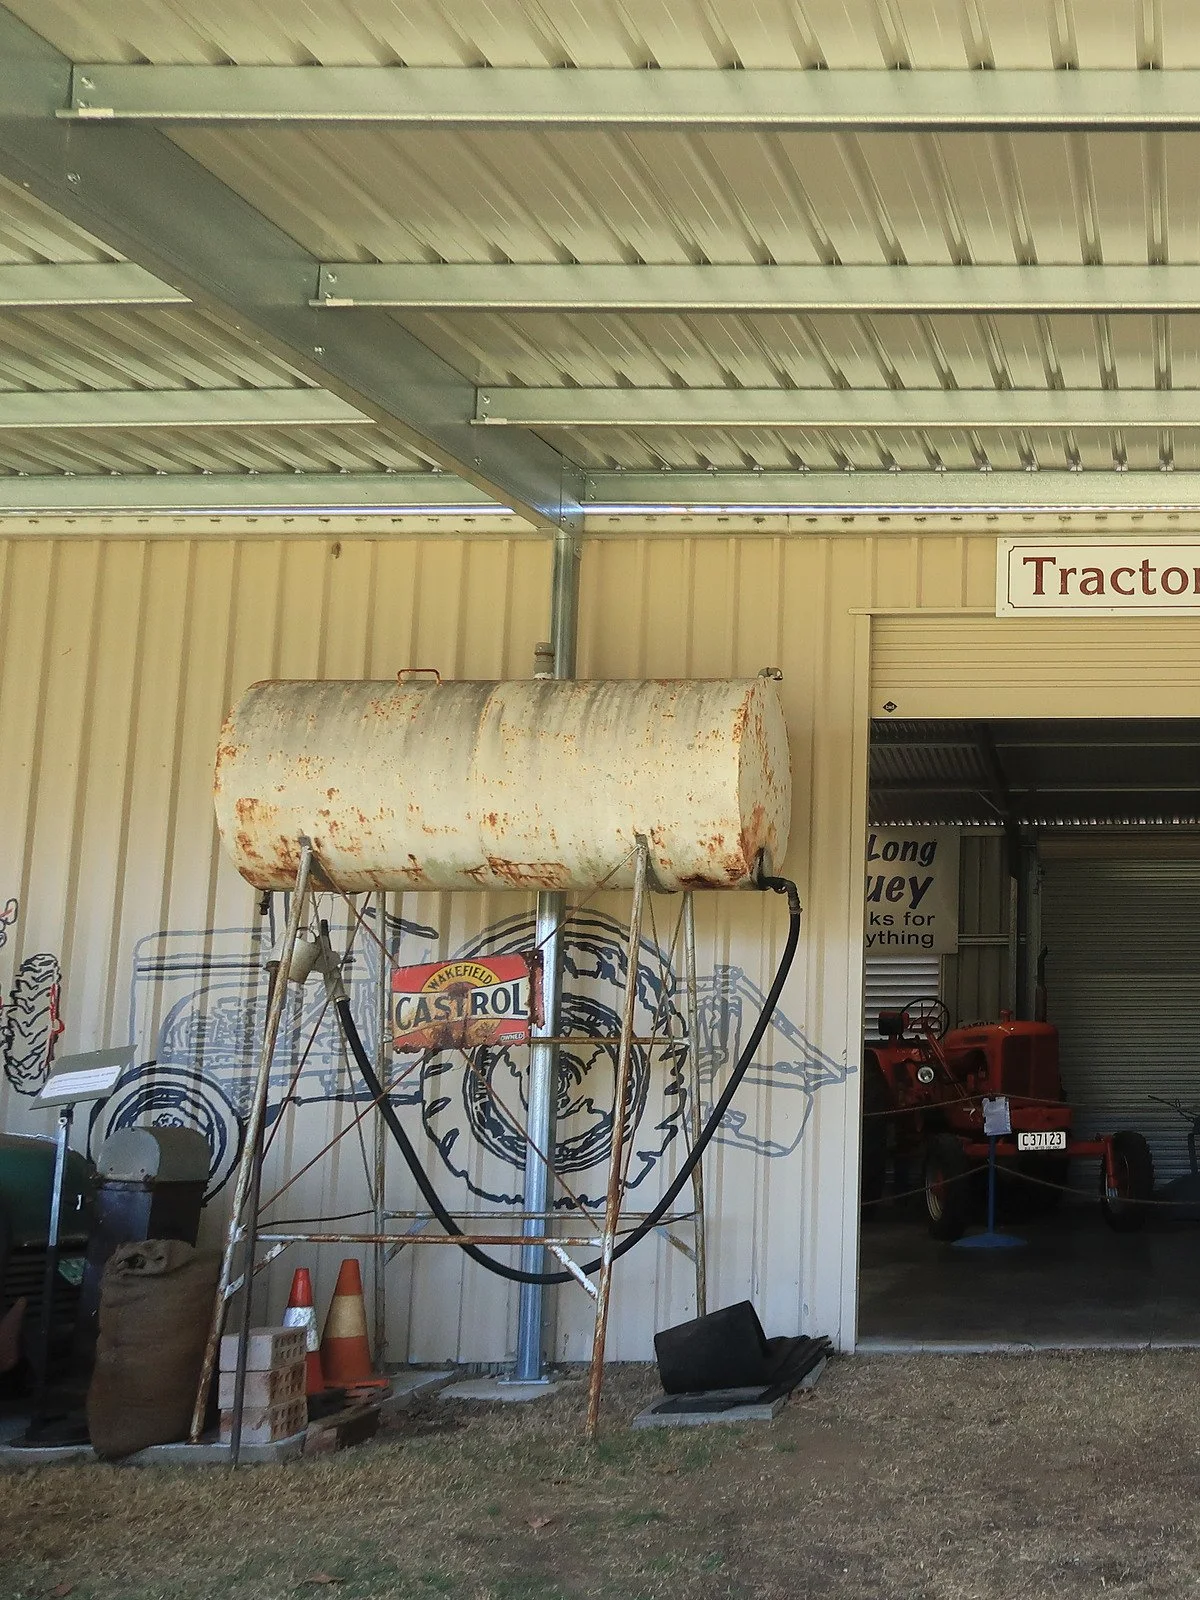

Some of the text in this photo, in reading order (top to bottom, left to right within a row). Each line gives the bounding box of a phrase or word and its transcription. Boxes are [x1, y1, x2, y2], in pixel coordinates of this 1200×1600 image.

[867, 833, 938, 868] Long
[903, 911, 936, 926] for
[866, 930, 934, 949] ything
[428, 965, 493, 989] WAKEFIELD
[395, 982, 529, 1031] CASTROL
[500, 1031, 524, 1042] OWNED
[1022, 1132, 1062, 1147] C37123
